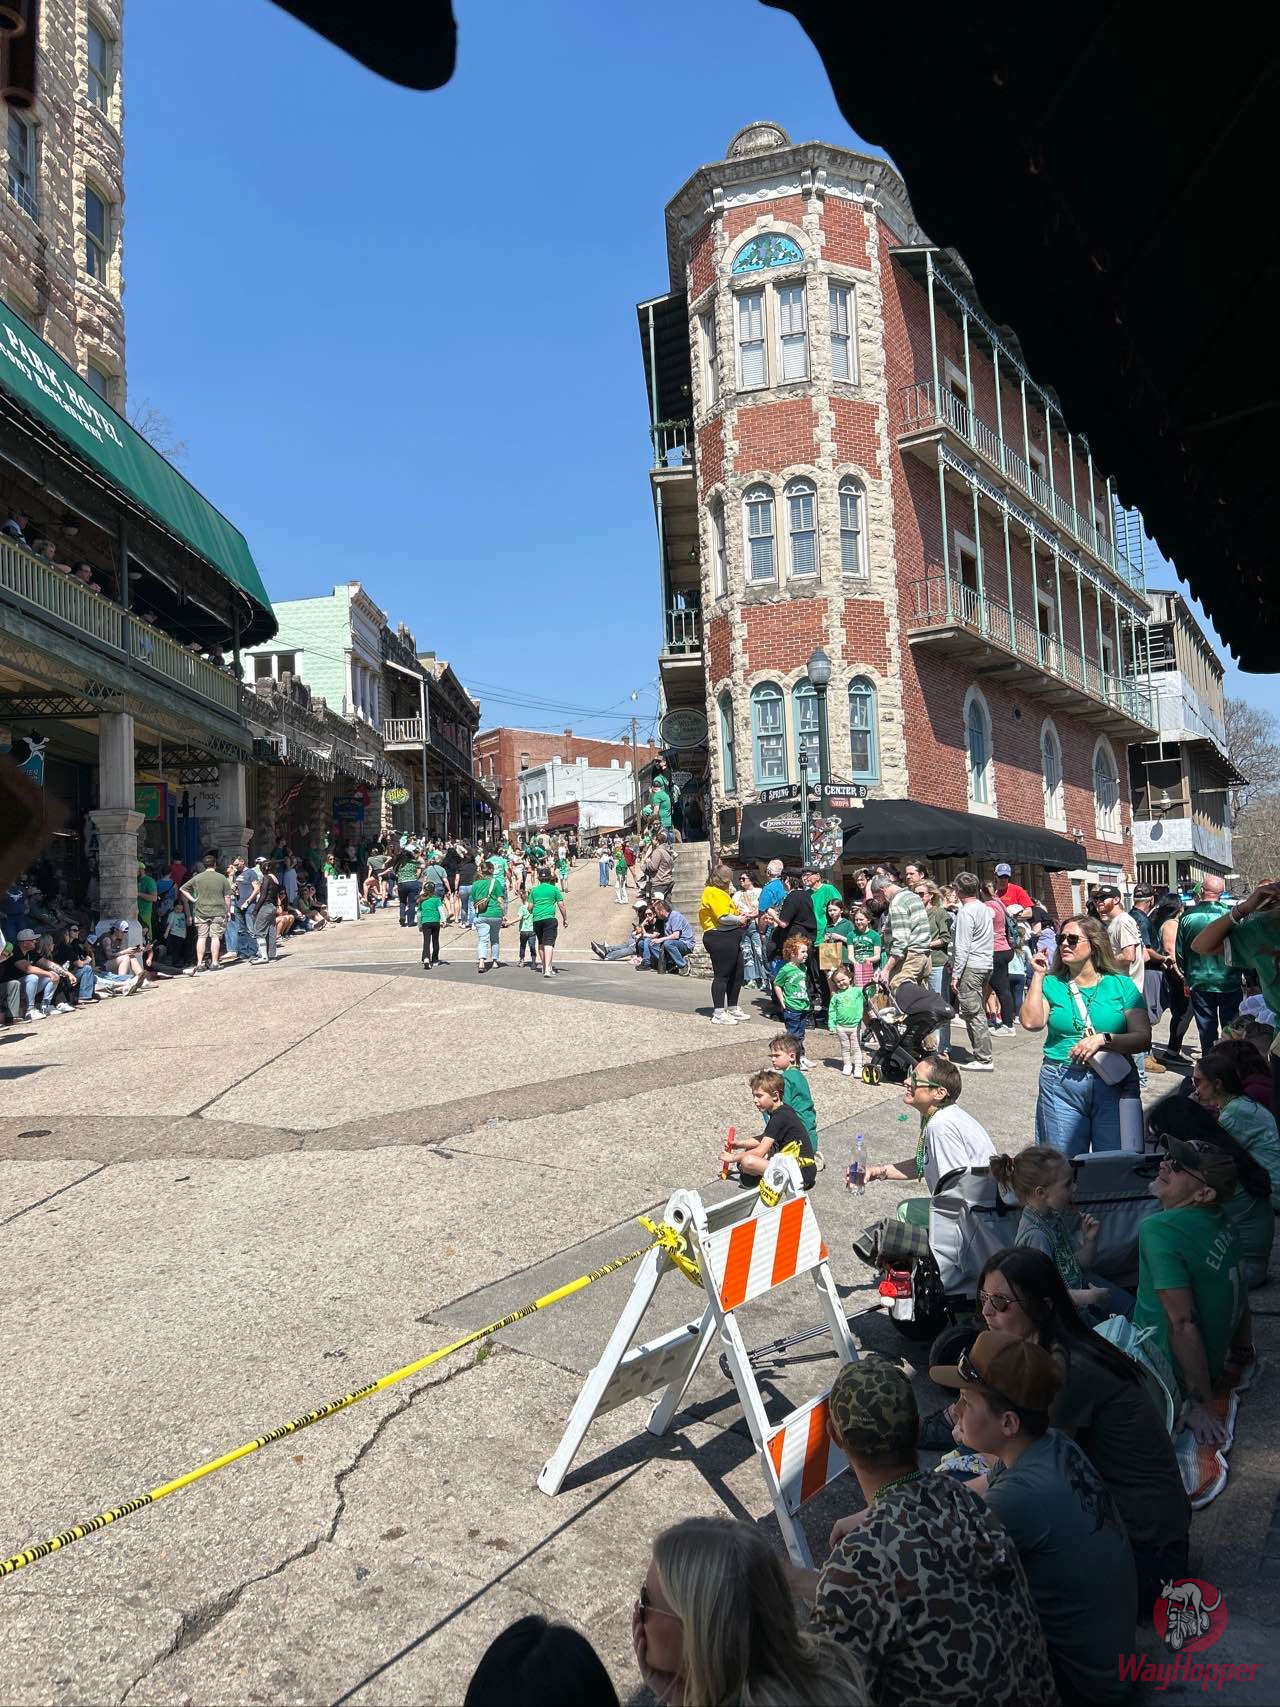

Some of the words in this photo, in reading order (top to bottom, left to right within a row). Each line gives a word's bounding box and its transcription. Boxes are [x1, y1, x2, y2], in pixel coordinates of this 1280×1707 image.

[2, 322, 64, 394] PARK
[63, 380, 123, 448] HOTEL
[33, 370, 104, 444] Restaurant
